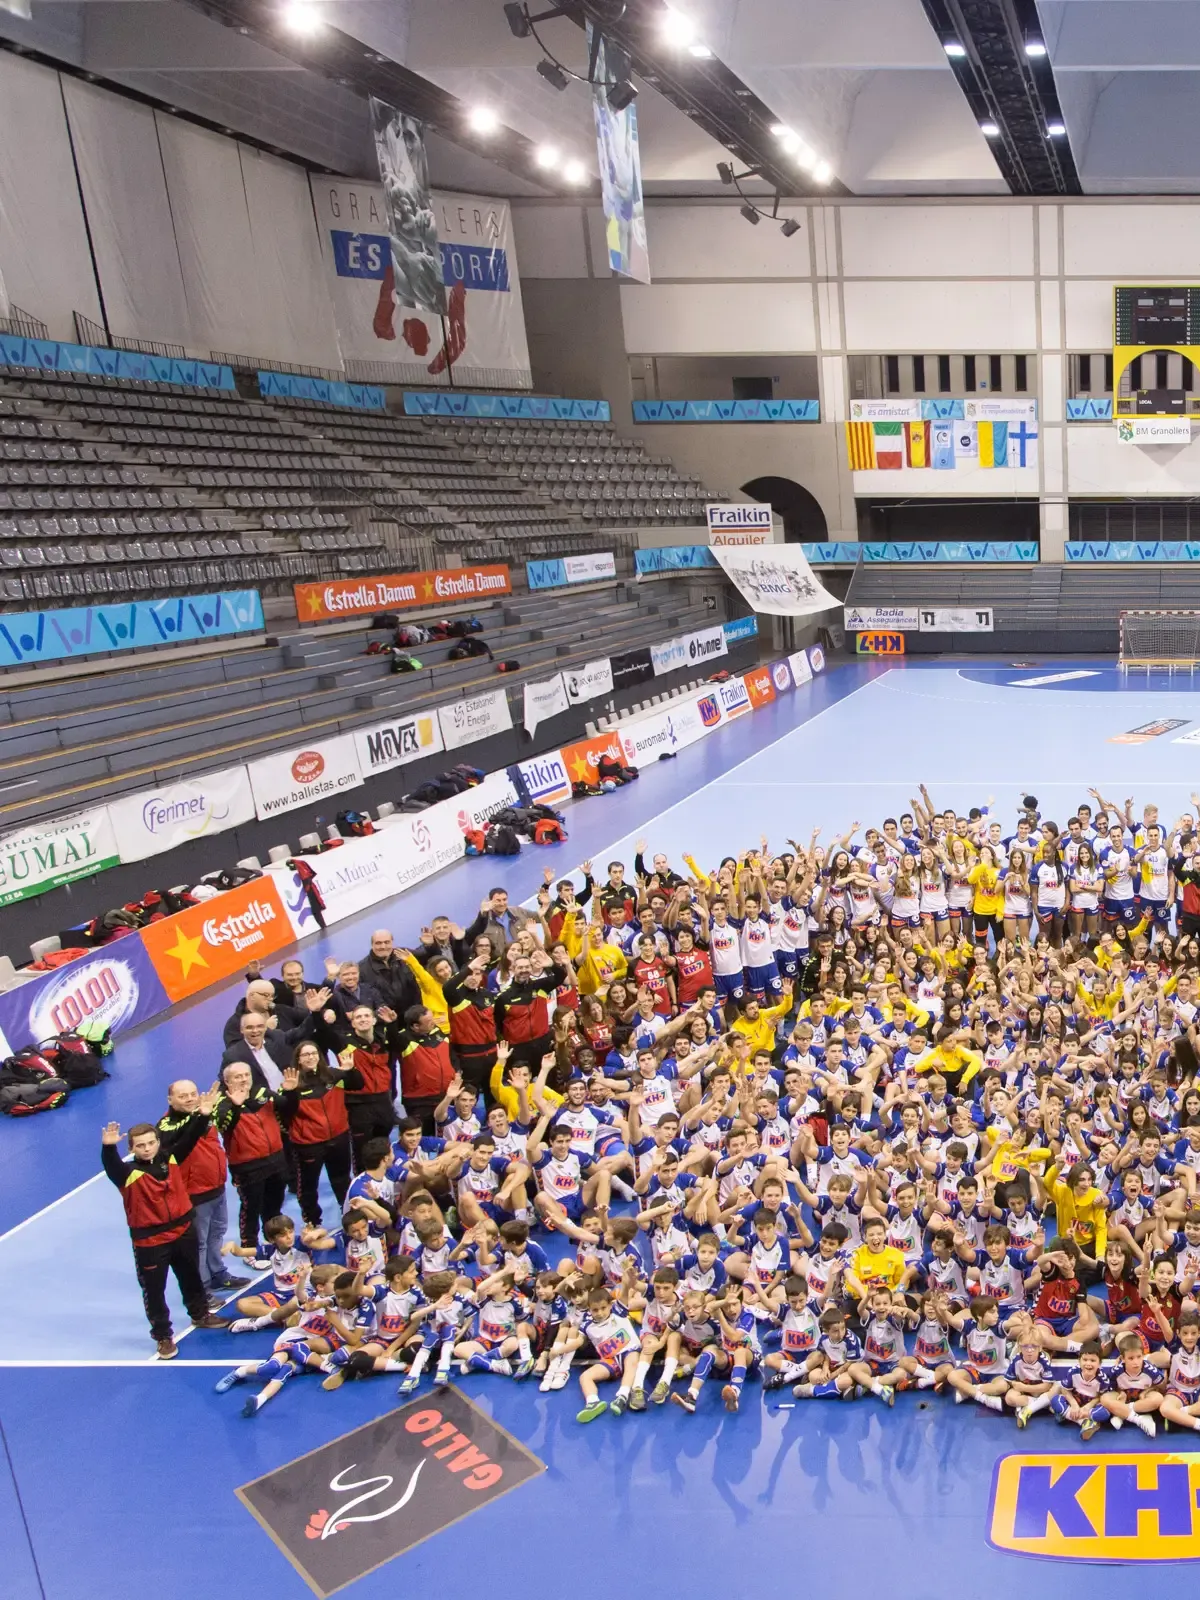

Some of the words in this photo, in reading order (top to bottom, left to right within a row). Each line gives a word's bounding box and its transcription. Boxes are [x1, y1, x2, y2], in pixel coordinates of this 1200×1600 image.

[329, 189, 501, 238] GRALERS
[1150, 427, 1190, 435] Granollers
[709, 508, 770, 522] Fraikin
[435, 574, 475, 596] Estrella
[475, 572, 506, 592] Damm
[760, 584, 791, 593] BMG
[324, 583, 376, 612] Estrella
[376, 584, 416, 606] Damm
[876, 608, 904, 616] Badia
[860, 636, 900, 652] KH-7
[720, 684, 746, 706] Fraikin
[636, 728, 668, 751] euromadi
[523, 760, 564, 790] aikin
[149, 794, 206, 830] ferimet
[436, 842, 462, 864] Energia
[314, 879, 336, 896] La
[202, 900, 276, 946] Estrella
[231, 930, 264, 952] Damm
[714, 937, 733, 949] KH-7
[683, 962, 704, 976] KH-7
[51, 966, 120, 1033] COLON
[644, 1090, 666, 1106] KH-7
[570, 1128, 593, 1140] KH-7
[600, 1334, 626, 1358] KH-7
[787, 1327, 814, 1347] KH-7
[918, 1338, 946, 1355] KH-7
[404, 1408, 504, 1490] GALLO
